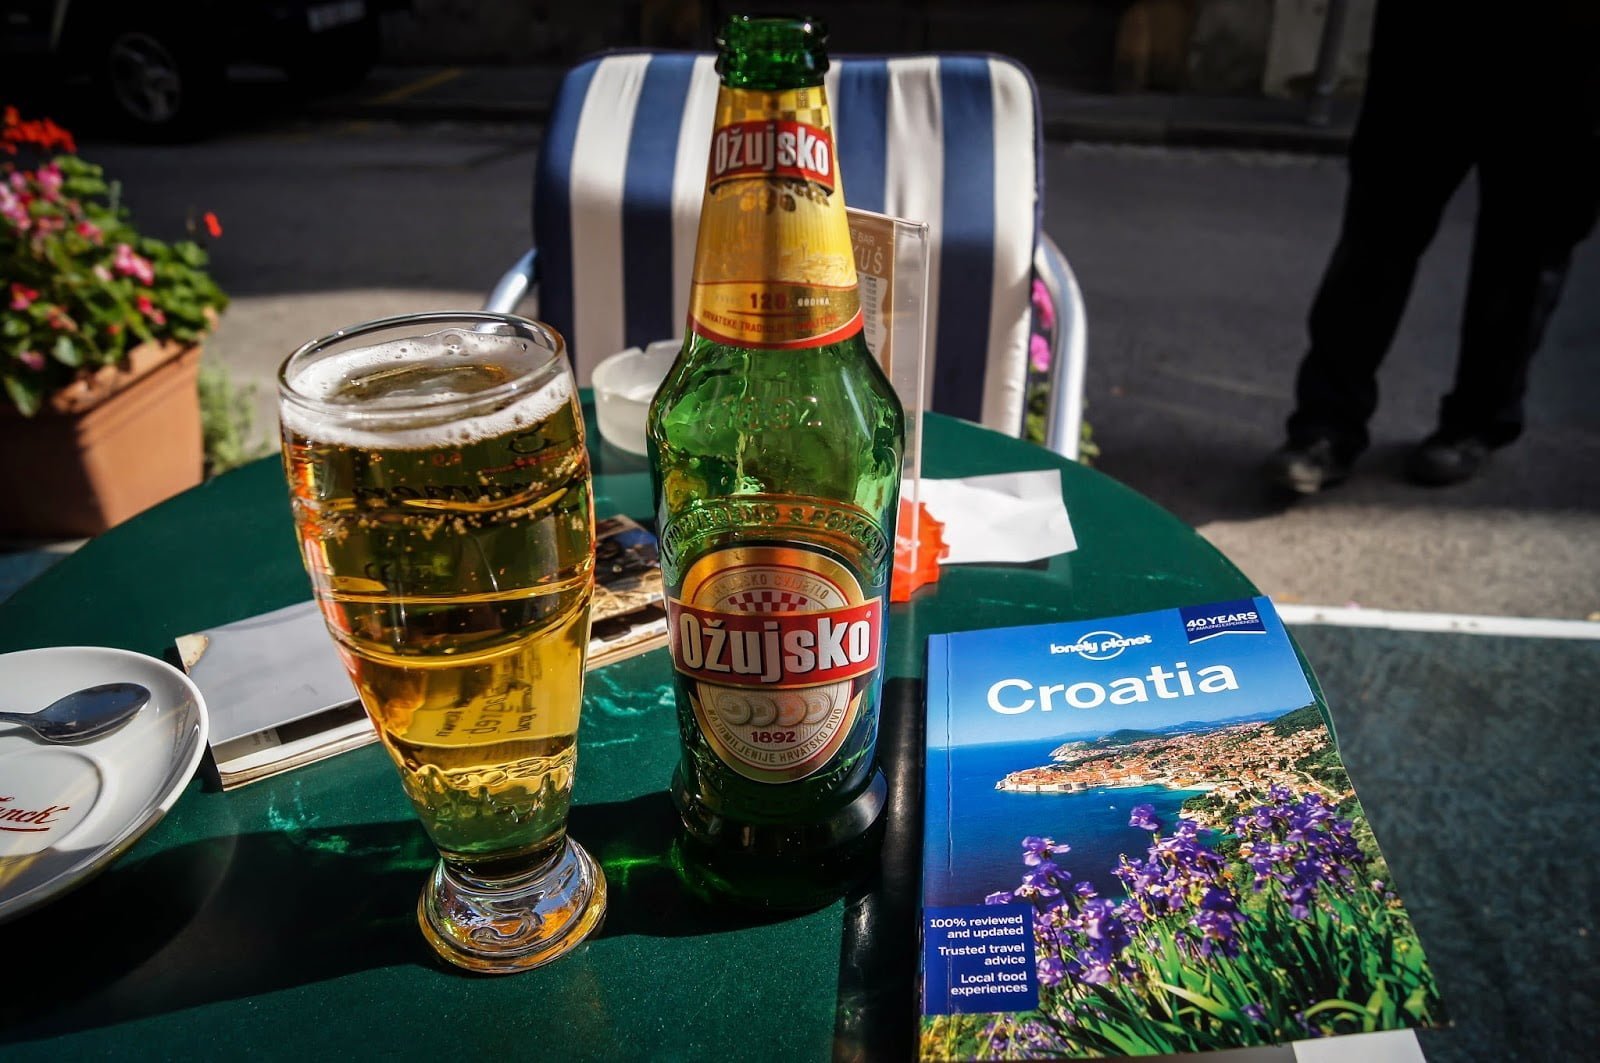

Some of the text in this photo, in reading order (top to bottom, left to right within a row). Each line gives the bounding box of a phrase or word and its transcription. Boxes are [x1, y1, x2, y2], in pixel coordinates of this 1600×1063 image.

[714, 124, 830, 177] Ožujsko
[750, 293, 788, 310] 120
[797, 297, 830, 307] GODINA
[703, 310, 738, 329] HRVATSKE
[1186, 611, 1258, 629] 40 YEARS
[679, 612, 871, 684] Ožujsko
[1050, 634, 1153, 654] lonely planet
[987, 661, 1240, 715] Croatia
[751, 731, 797, 744] 1892
[779, 731, 828, 763] HRVATSKO
[826, 707, 843, 730] PIVO
[930, 914, 1023, 929] 100% reviewed
[947, 925, 1025, 939] and updated
[938, 942, 1026, 956] Trusted travel
[984, 955, 1026, 966] advice
[960, 970, 1028, 984] Local food
[950, 983, 1029, 997] experiences
